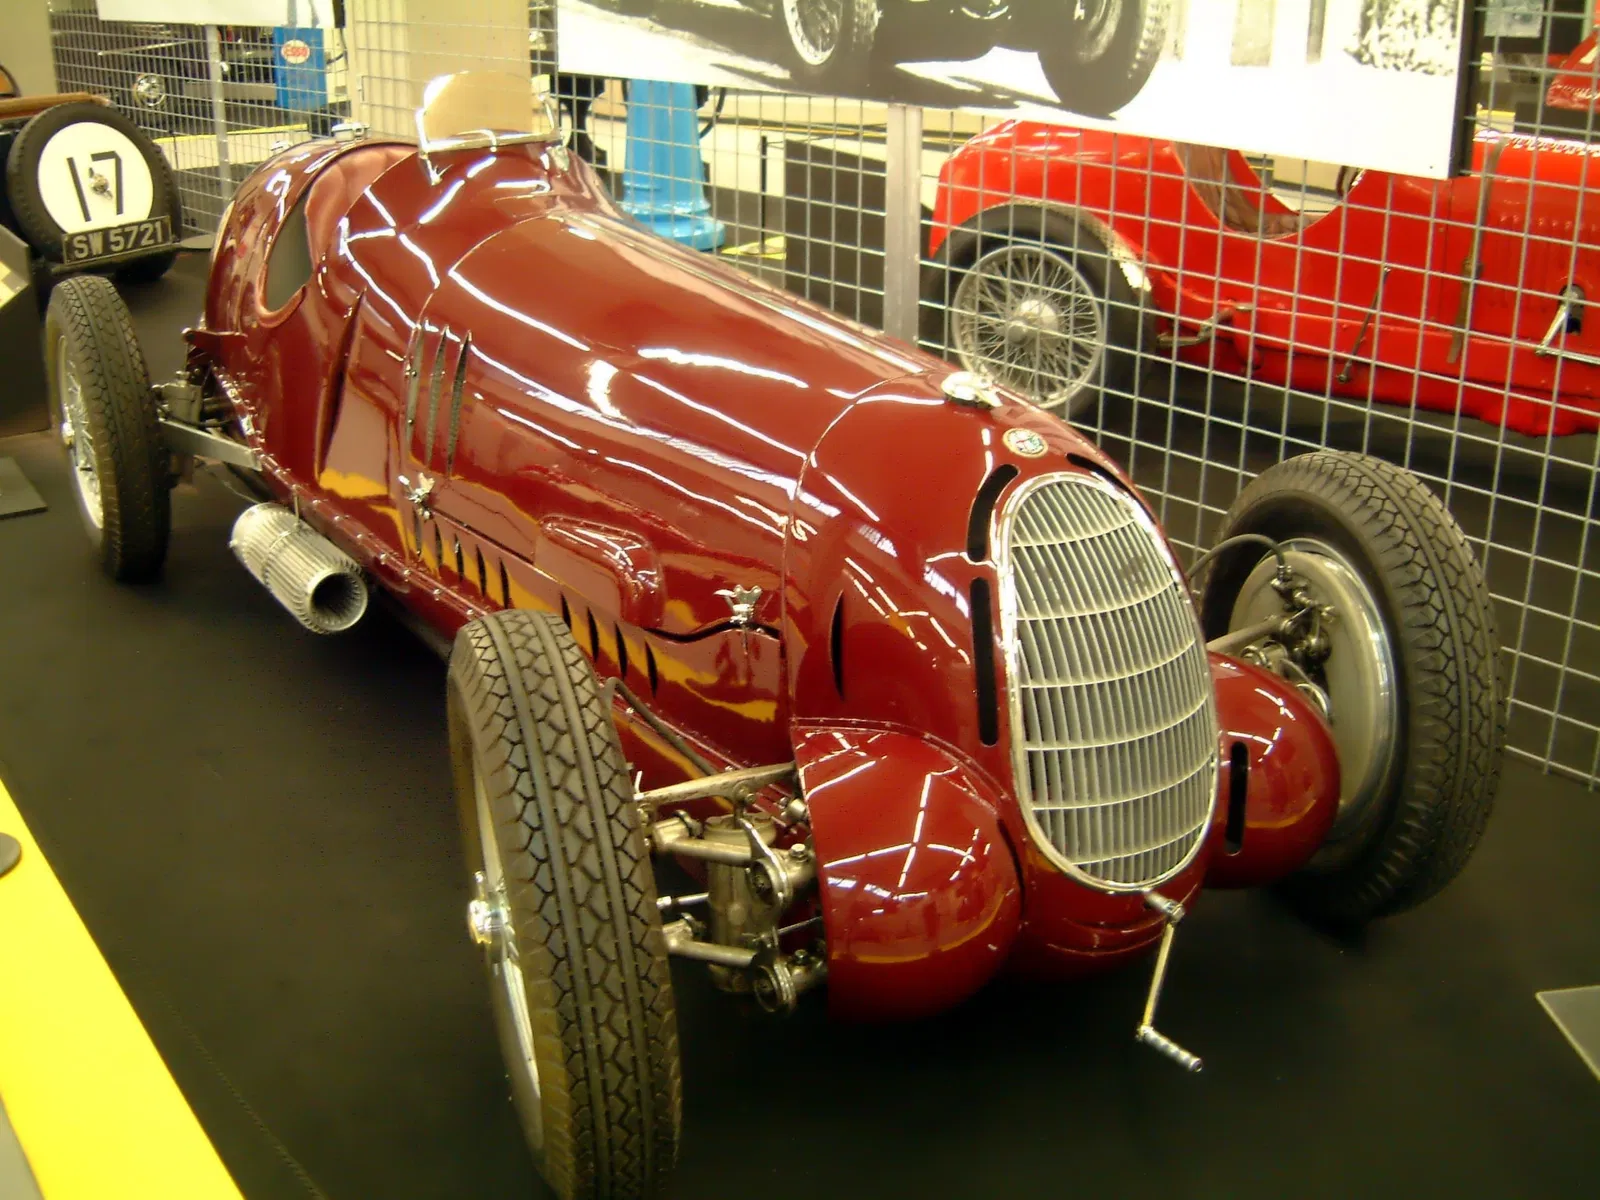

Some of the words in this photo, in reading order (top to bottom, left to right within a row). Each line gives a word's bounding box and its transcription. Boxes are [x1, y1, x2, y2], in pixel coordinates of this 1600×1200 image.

[66, 150, 123, 222] 17
[73, 231, 103, 258] SW
[109, 221, 163, 252] 5721
